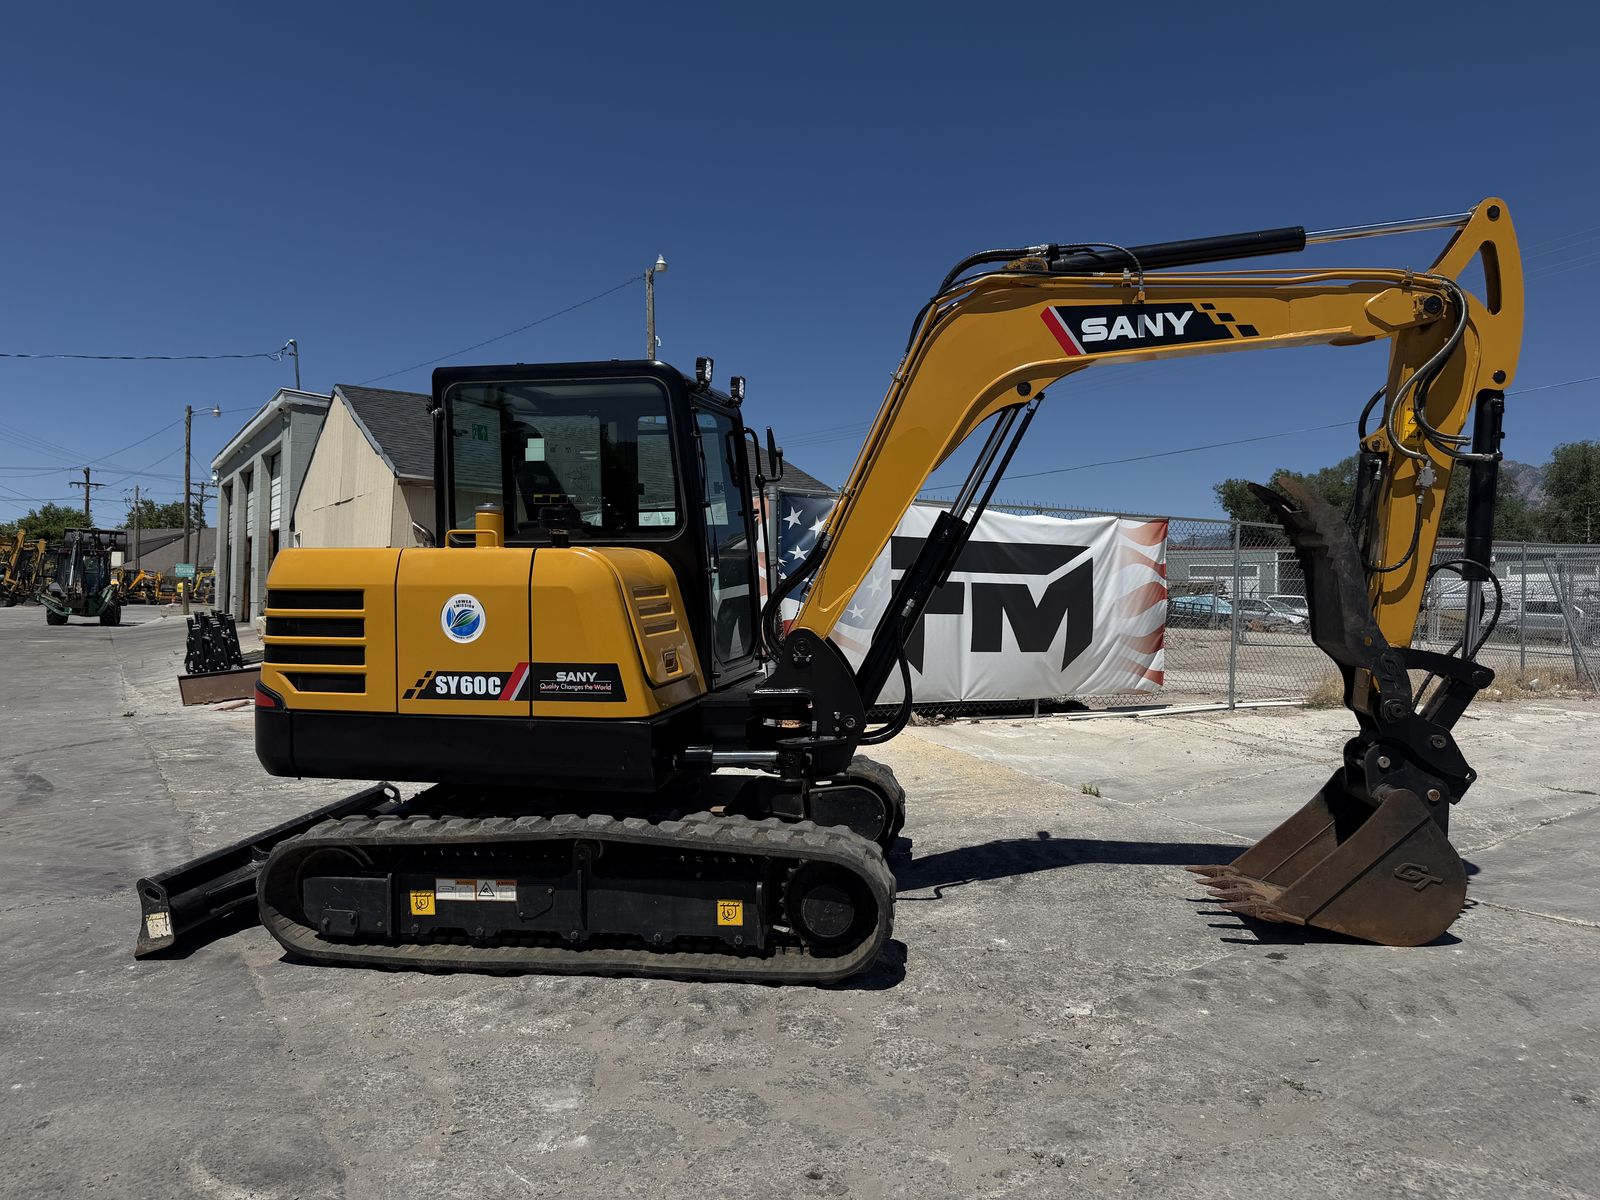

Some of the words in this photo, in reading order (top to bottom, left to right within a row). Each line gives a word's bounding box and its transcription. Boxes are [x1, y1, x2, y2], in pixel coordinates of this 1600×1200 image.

[1080, 310, 1194, 342] SANY
[556, 671, 597, 682] SANY
[435, 675, 501, 695] SY60C
[540, 682, 559, 691] Quality
[560, 683, 584, 692] Changes
